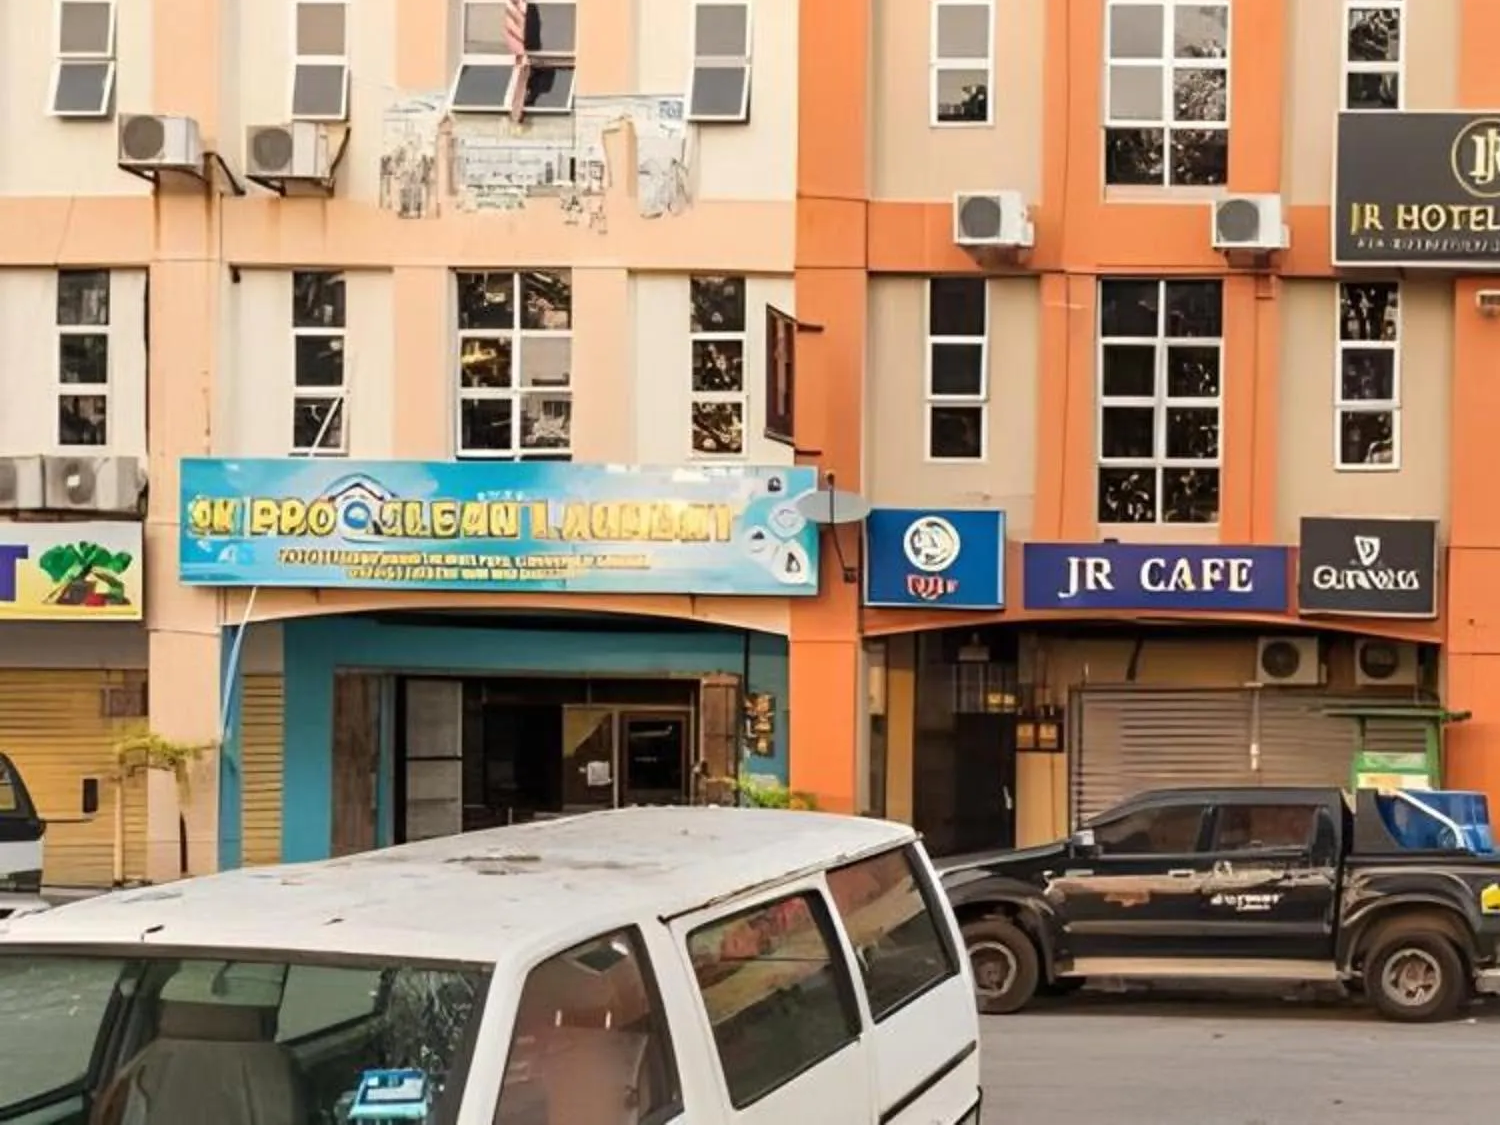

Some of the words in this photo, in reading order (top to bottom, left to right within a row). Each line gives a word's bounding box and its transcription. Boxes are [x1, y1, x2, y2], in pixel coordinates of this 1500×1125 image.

[1350, 202, 1384, 234] JR
[1058, 557, 1115, 598] JR
[1140, 557, 1253, 593] CAFE
